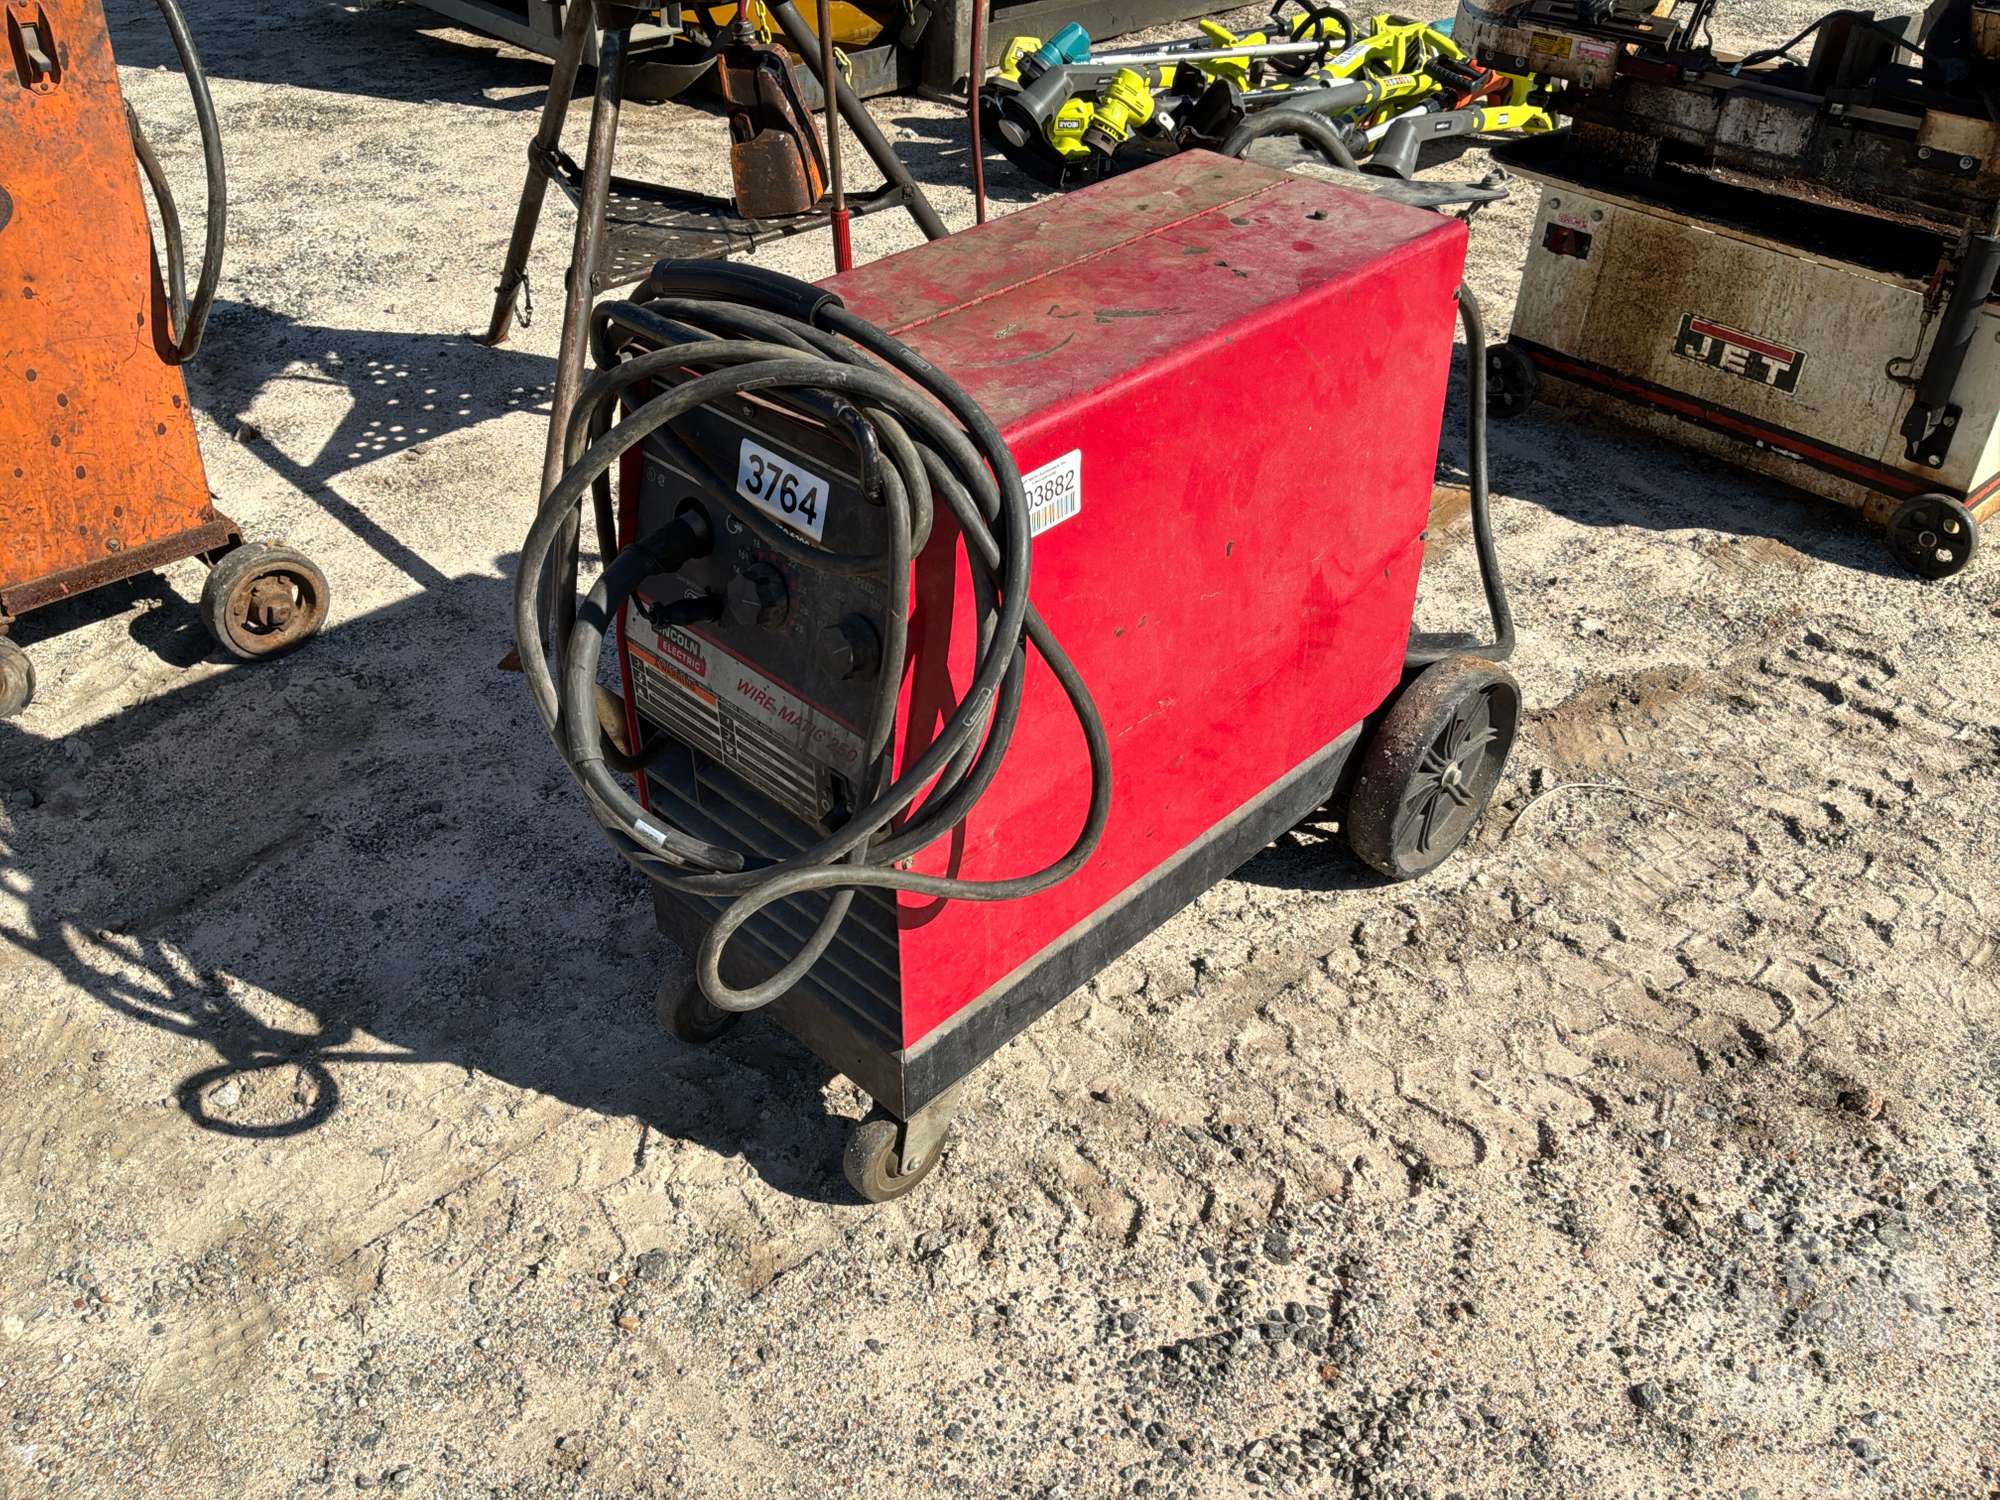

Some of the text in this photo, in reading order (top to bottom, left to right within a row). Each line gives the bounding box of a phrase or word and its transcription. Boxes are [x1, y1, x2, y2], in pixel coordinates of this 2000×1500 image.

[1683, 335, 1791, 385] JET
[745, 454, 818, 525] 3764
[1025, 469, 1074, 511] 03882
[655, 626, 699, 655] NCOLN
[662, 639, 701, 671] ELECTRIC
